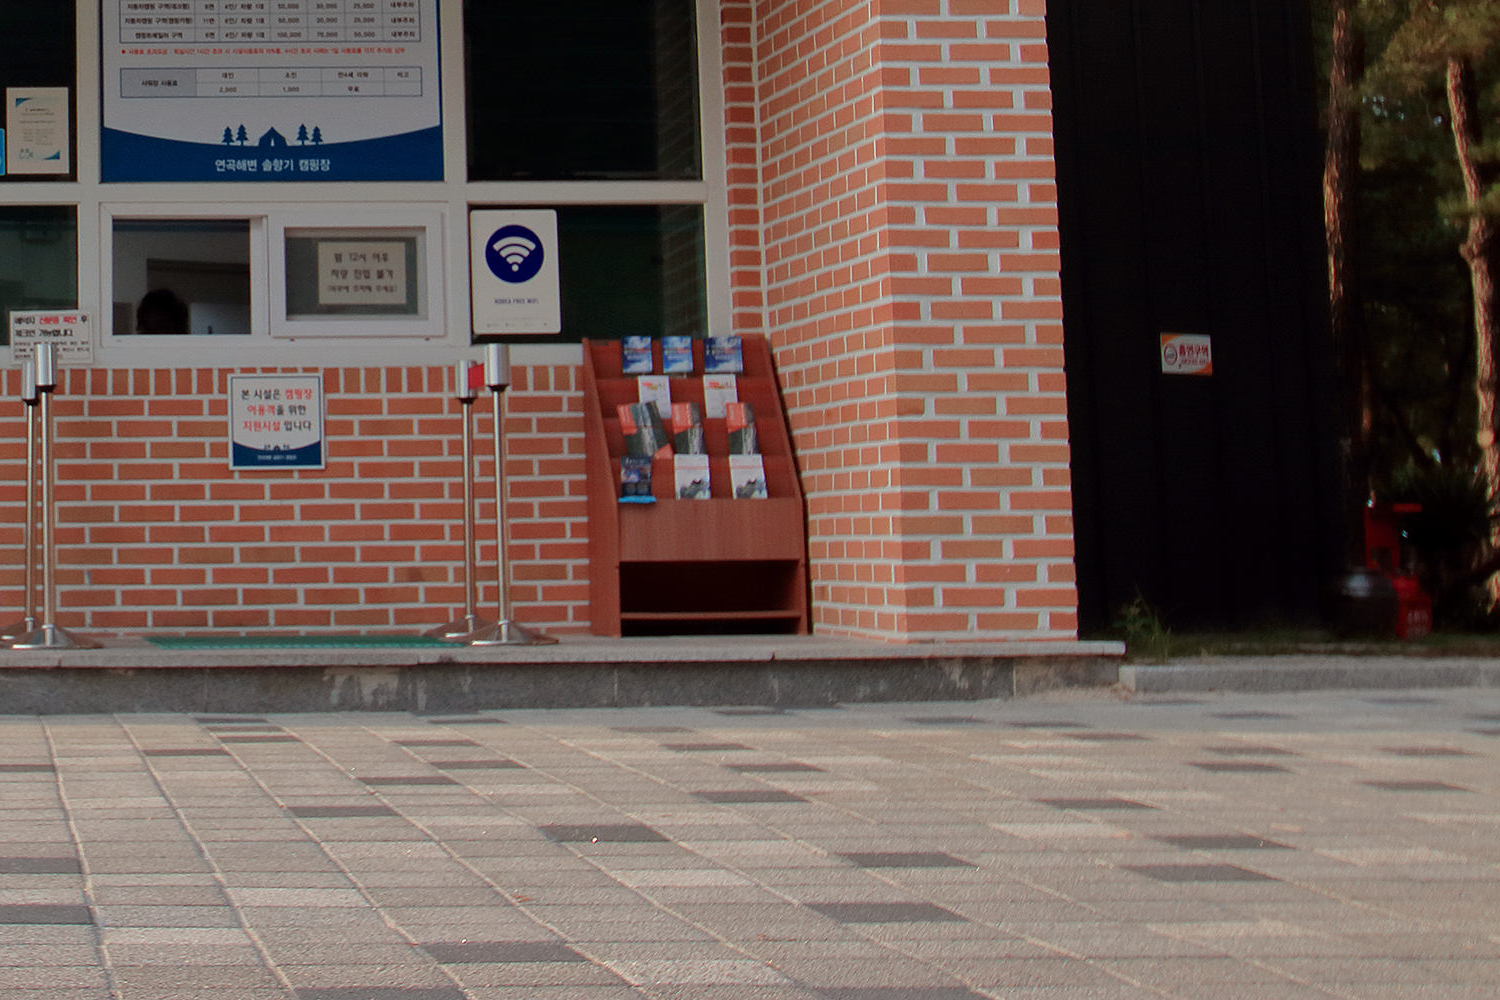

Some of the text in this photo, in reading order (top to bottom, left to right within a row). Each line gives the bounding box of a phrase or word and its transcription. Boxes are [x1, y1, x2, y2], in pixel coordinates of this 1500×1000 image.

[215, 160, 331, 172] 연곡해변 솔향기 캠핑장
[241, 388, 312, 400] 본 시설은 캠핑장
[288, 405, 306, 415] 위한
[284, 421, 311, 431] 입니다
